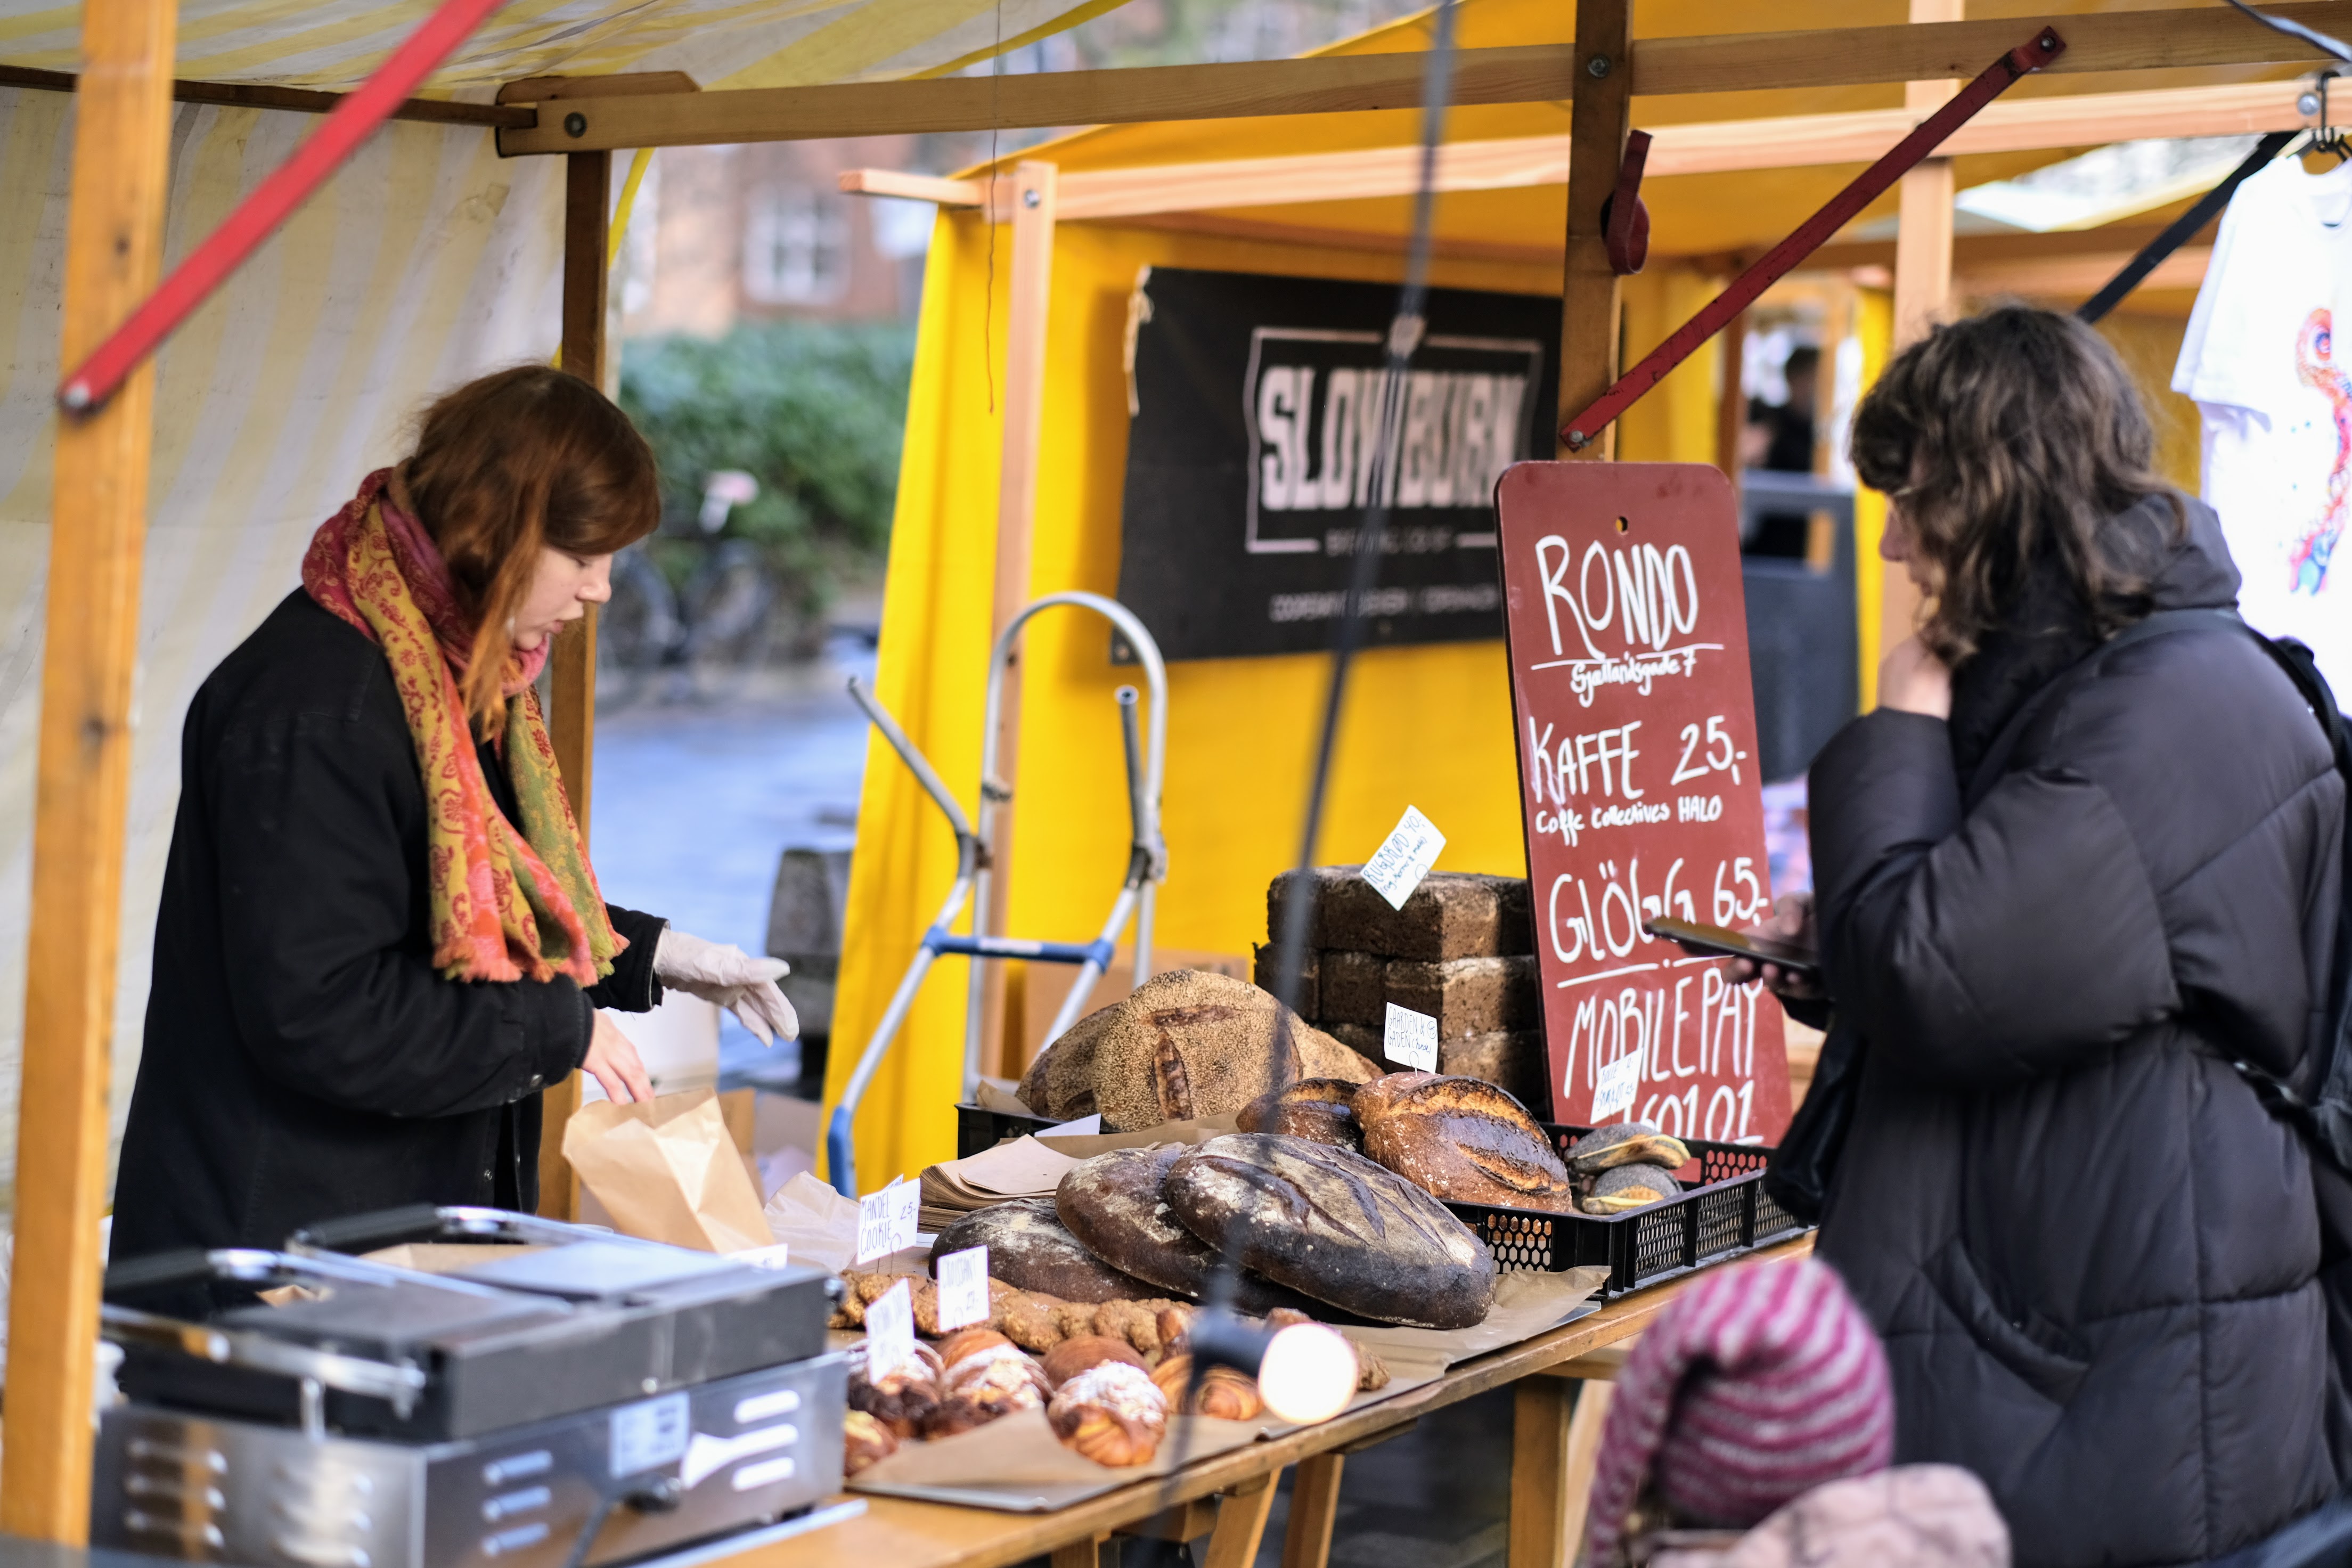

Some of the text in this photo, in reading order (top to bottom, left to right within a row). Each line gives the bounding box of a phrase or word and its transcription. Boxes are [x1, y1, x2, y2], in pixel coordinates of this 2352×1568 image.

[1536, 535, 1698, 659] RONDO
[1681, 649, 1696, 677] 7
[1529, 716, 1644, 805] KAFFE
[1678, 795, 1722, 823] HALO
[1387, 1027, 1410, 1048] GADEN
[860, 1220, 892, 1255] COOKIE
